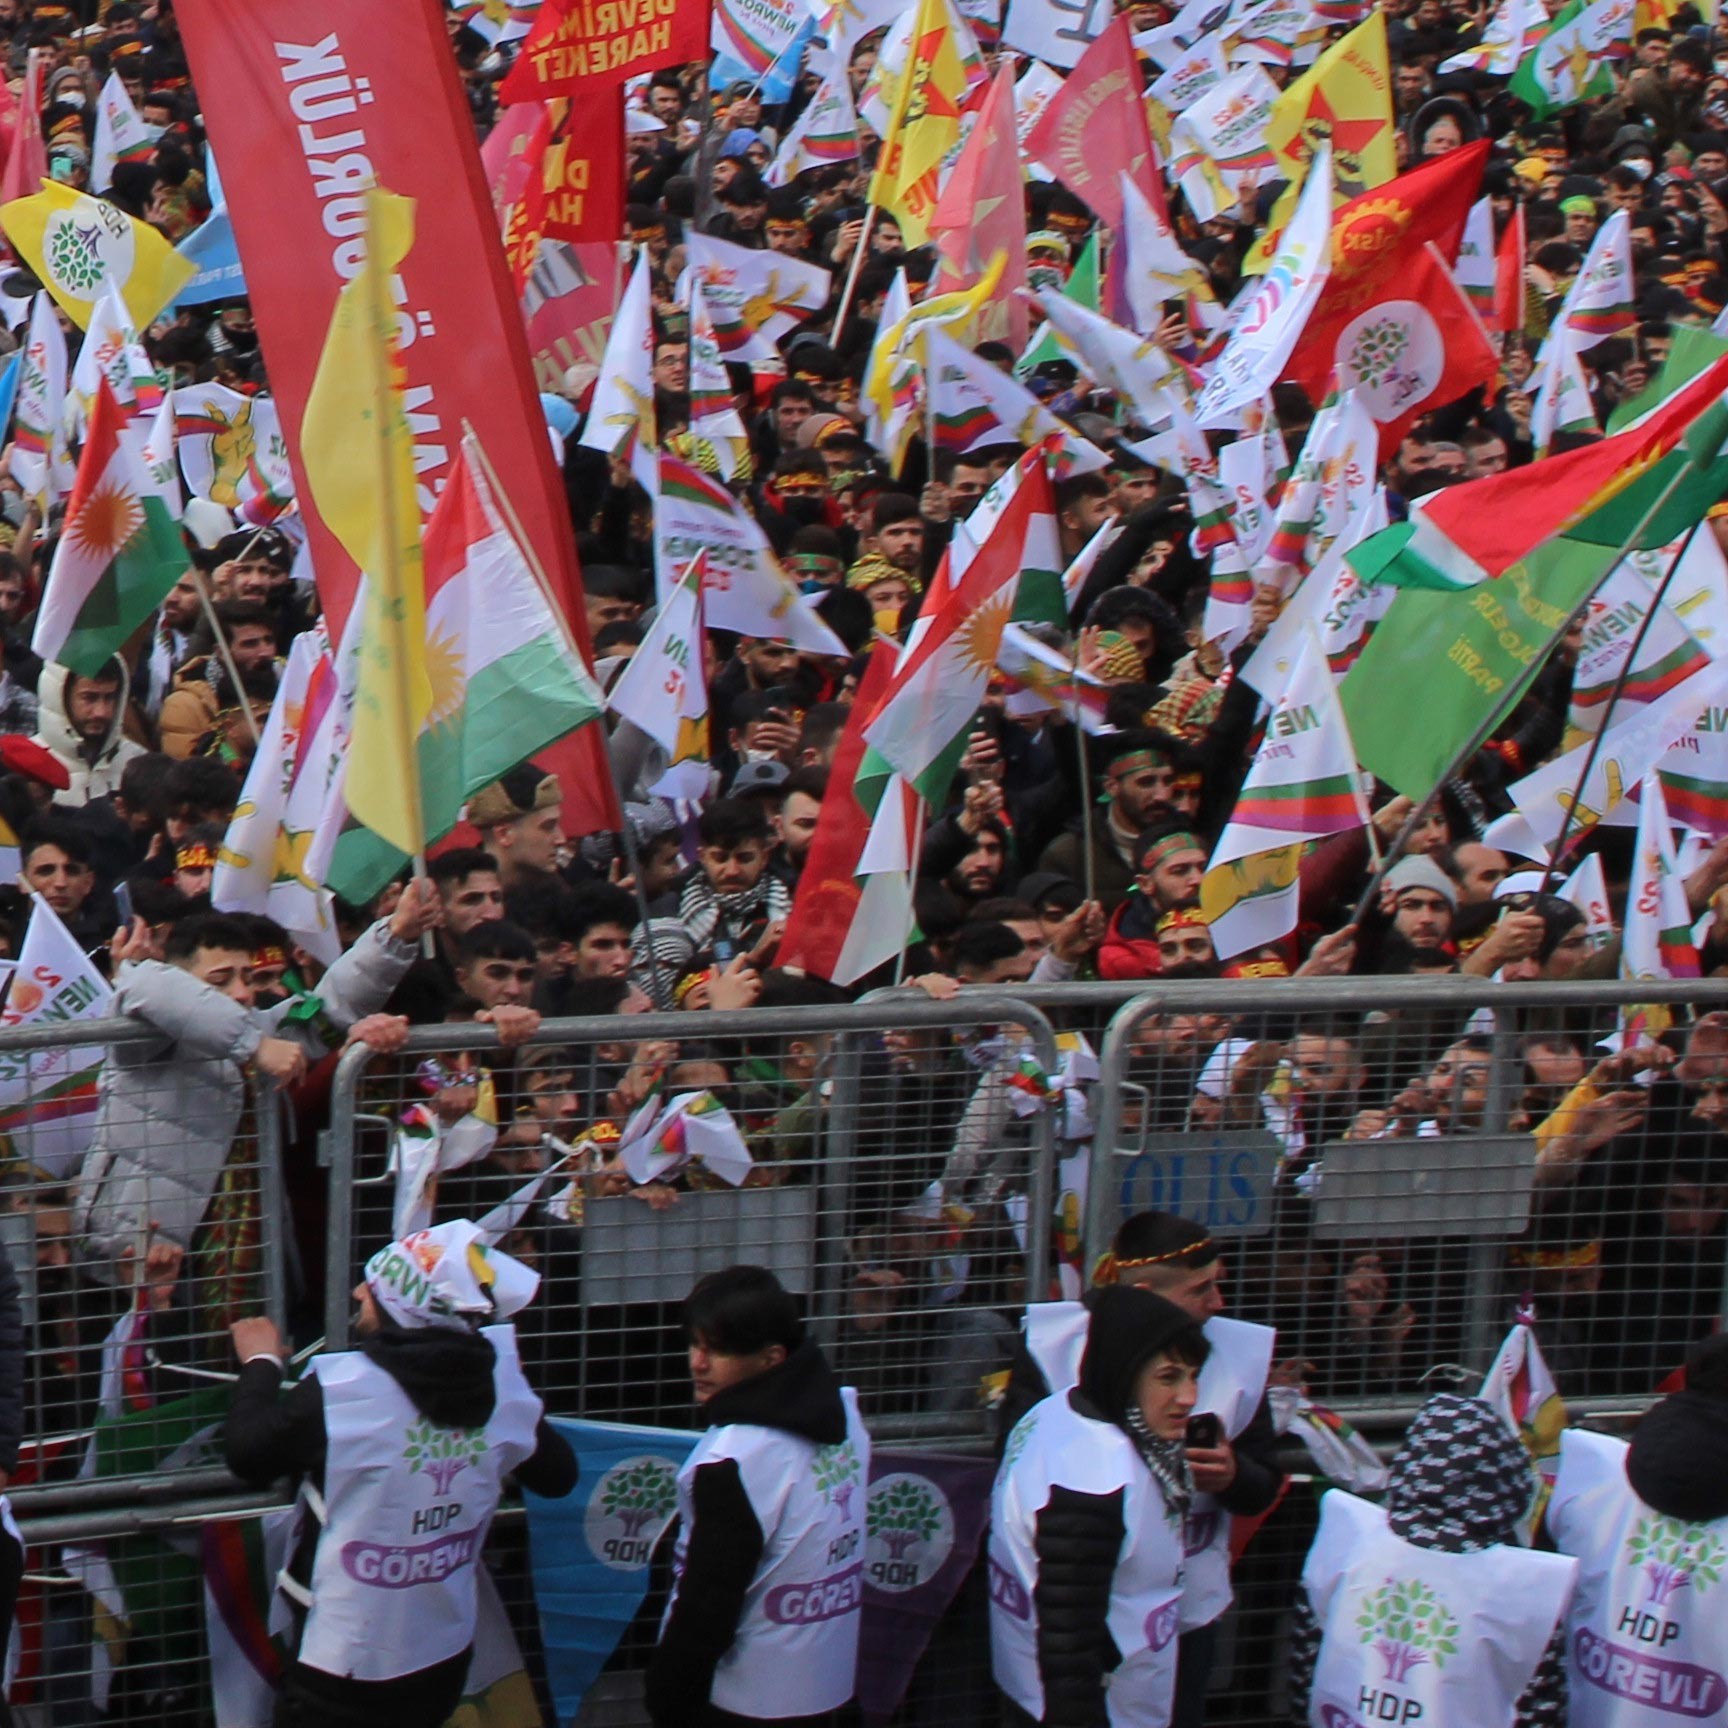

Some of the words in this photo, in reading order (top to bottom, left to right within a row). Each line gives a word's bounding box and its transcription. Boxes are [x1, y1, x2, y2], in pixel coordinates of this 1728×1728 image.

[1119, 1135, 1260, 1230] OLİS
[410, 1502, 463, 1536] HDP
[1616, 1605, 1681, 1648] HDP
[1573, 1634, 1718, 1713] GÖREVLİ
[1358, 1685, 1424, 1727] HDP
